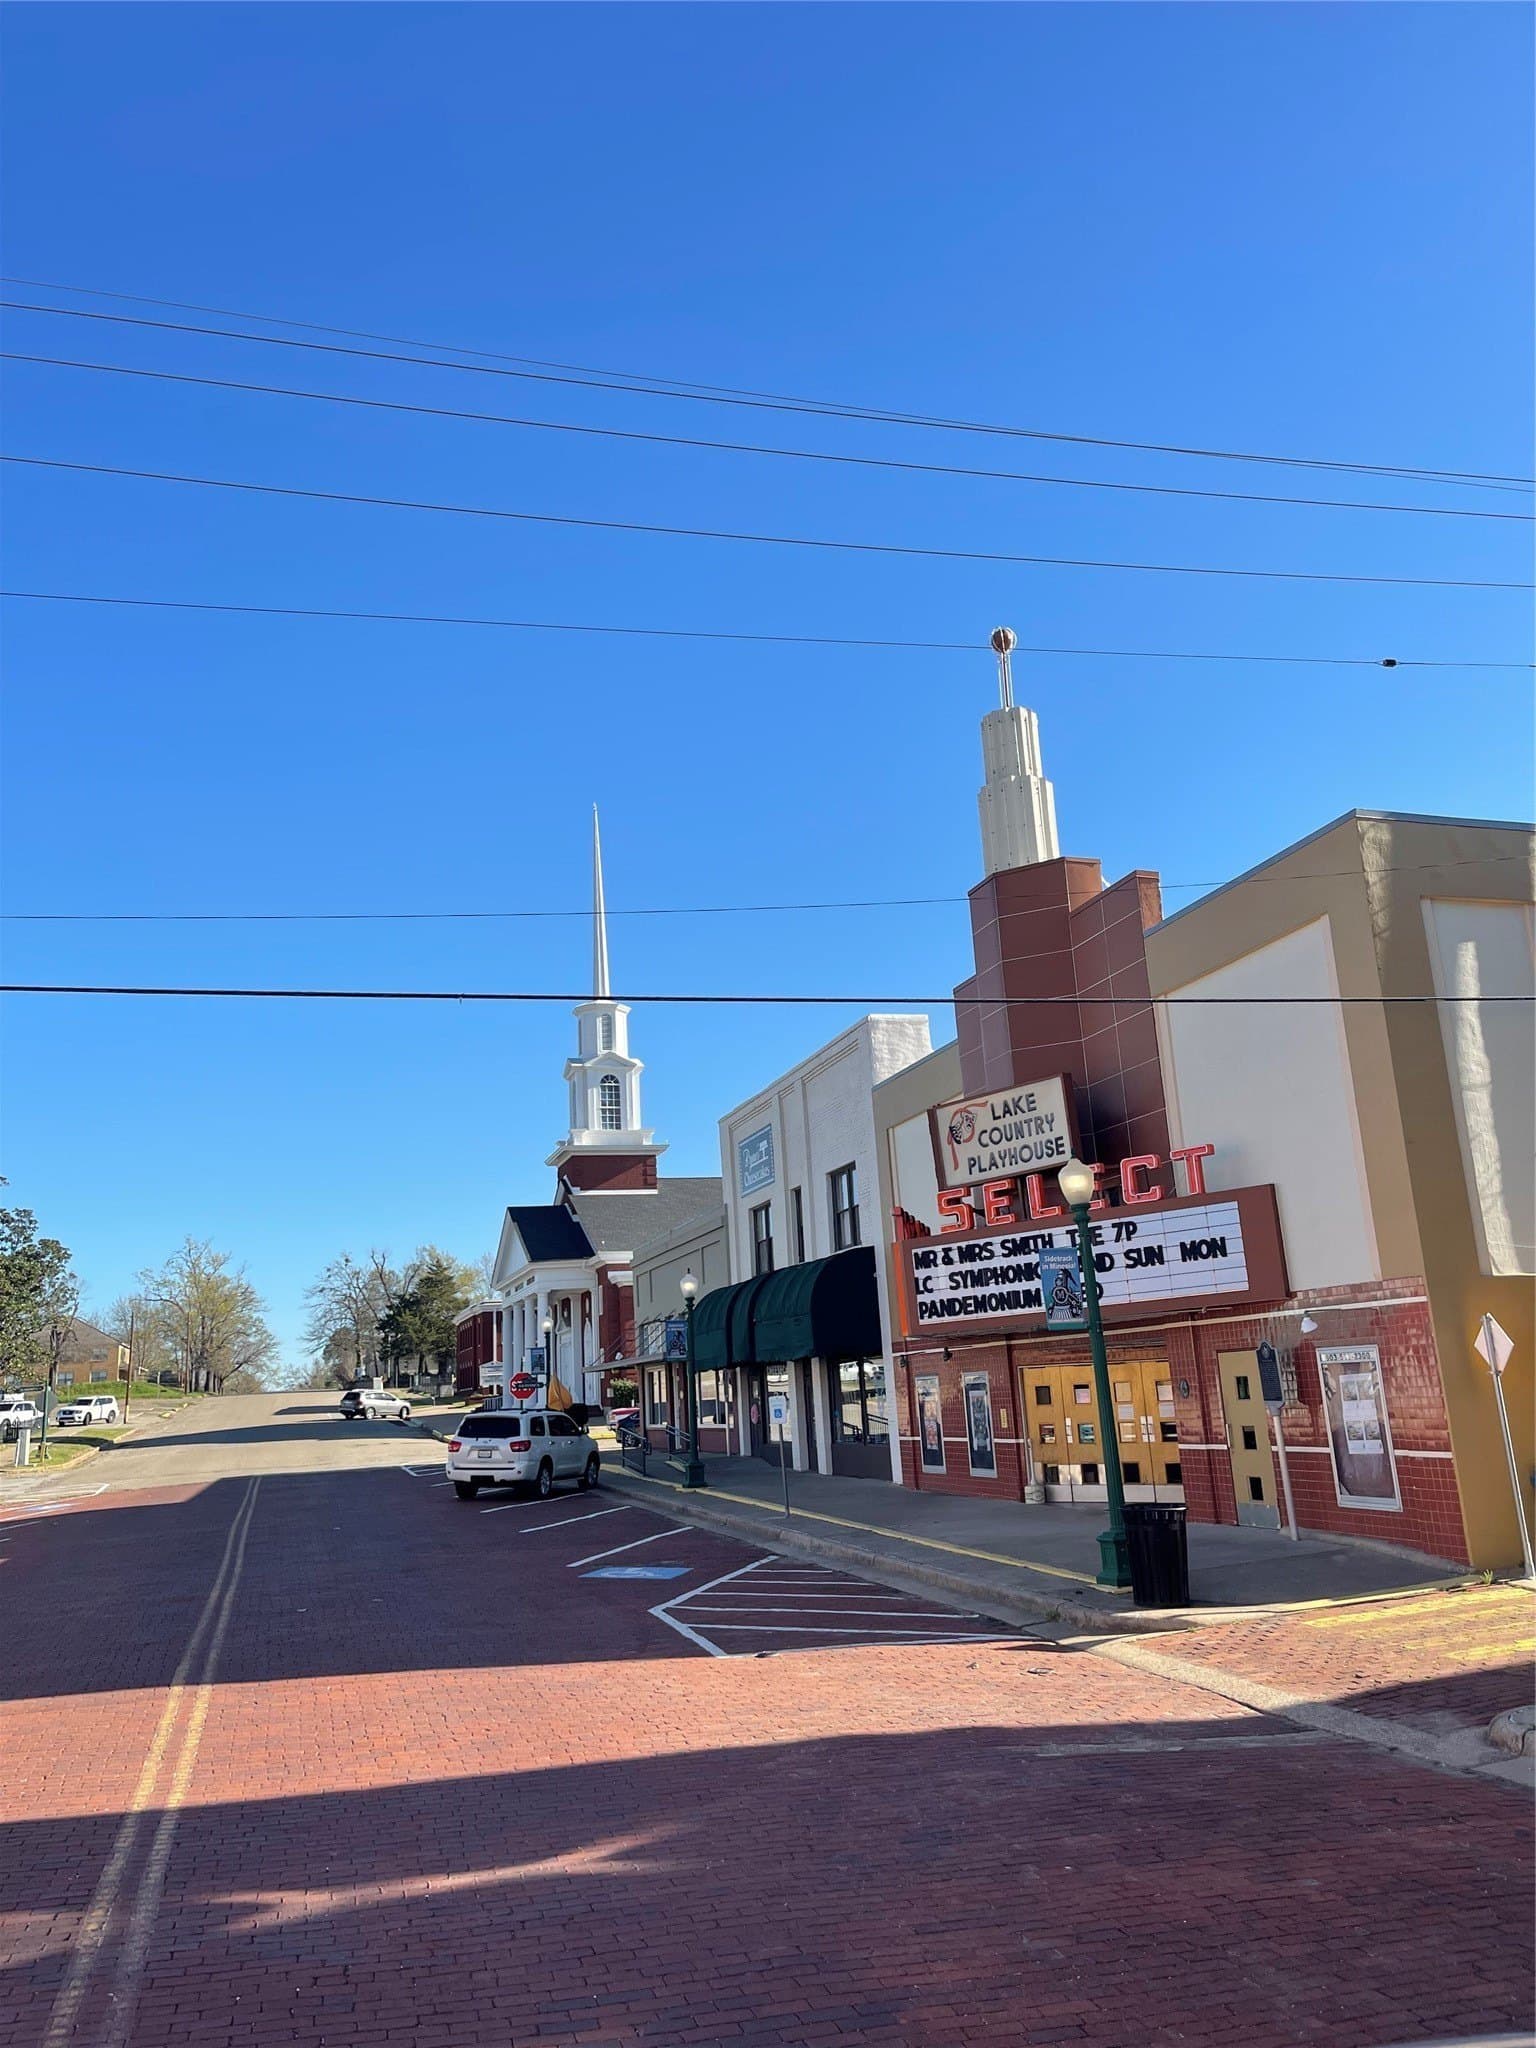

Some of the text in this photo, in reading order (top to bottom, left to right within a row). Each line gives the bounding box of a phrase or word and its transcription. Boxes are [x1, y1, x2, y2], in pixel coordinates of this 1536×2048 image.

[991, 1092, 1037, 1121] LAKE
[978, 1113, 1055, 1148] COUNTRY
[968, 1135, 1066, 1175] PLAYHOUSE
[913, 1221, 1138, 1270] MR & MRS SMITH TE 7P
[1044, 1255, 1073, 1263] Sidetrack
[915, 1275, 934, 1295] LC
[1123, 1245, 1165, 1269] SUN
[1180, 1236, 1228, 1263] MON
[919, 1288, 1043, 1320] PANDEMONIUM
